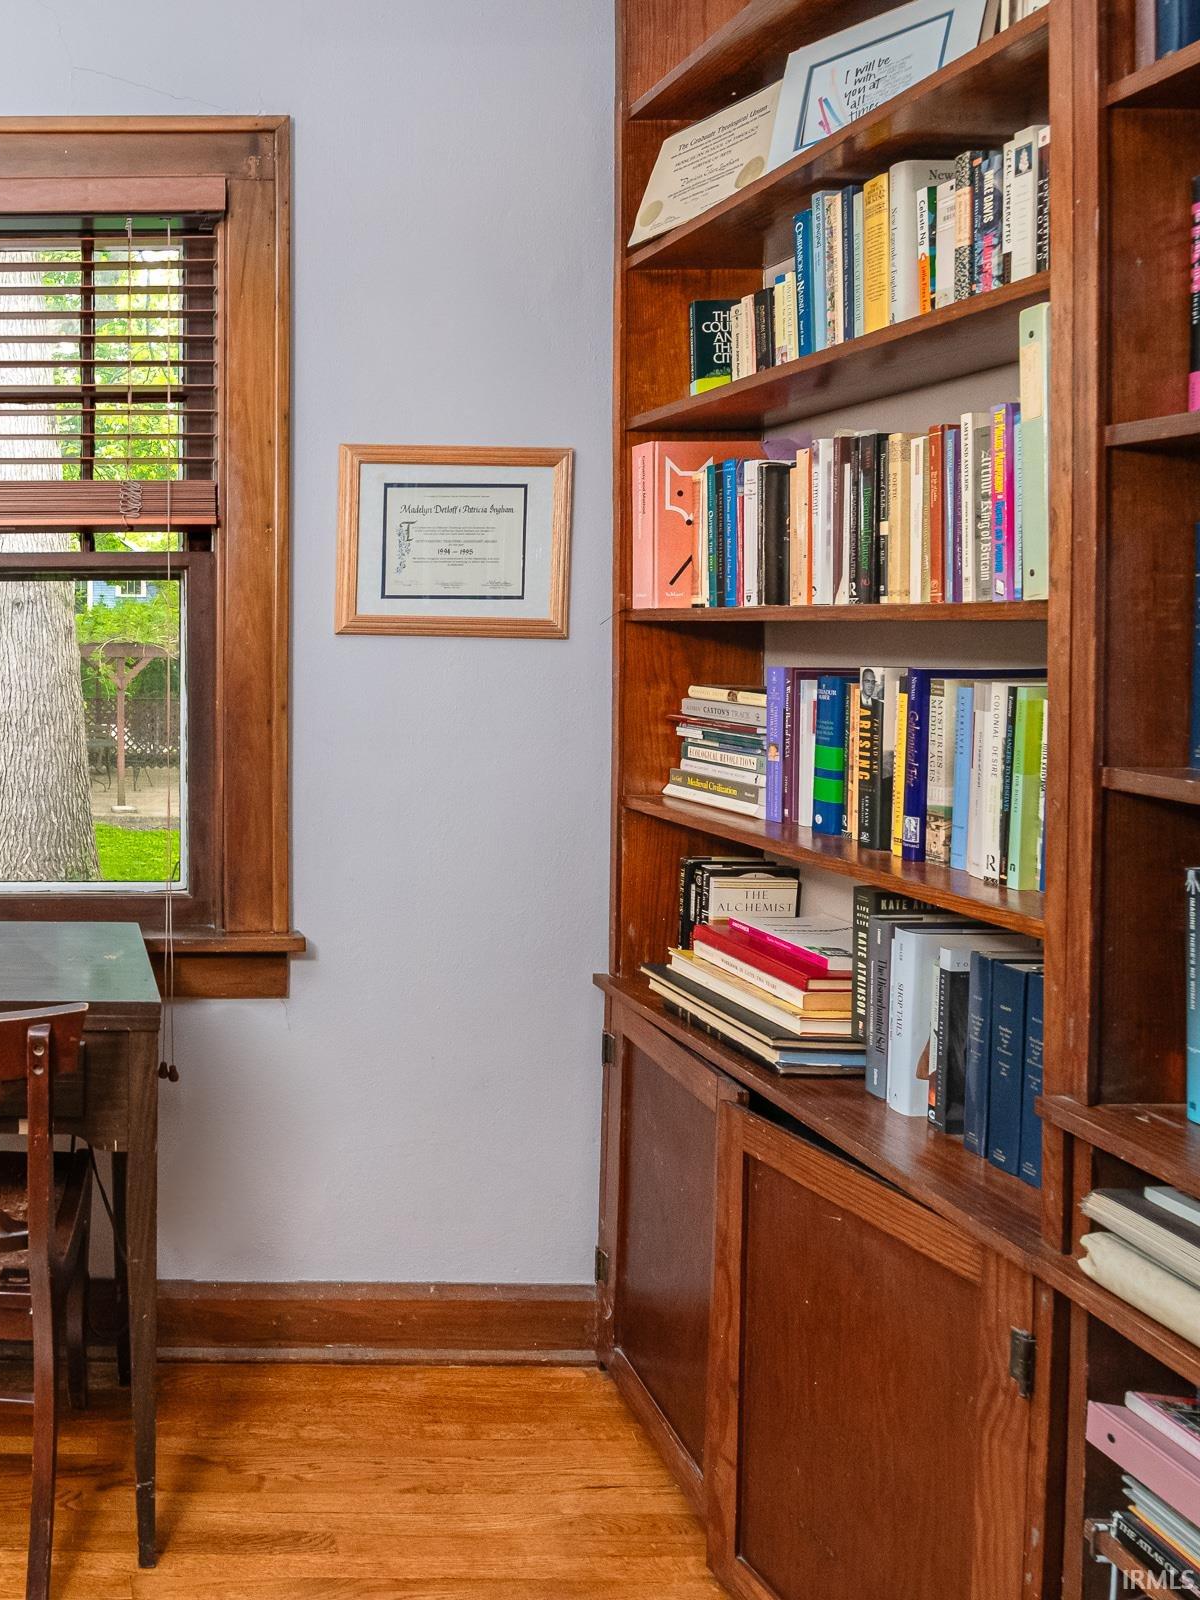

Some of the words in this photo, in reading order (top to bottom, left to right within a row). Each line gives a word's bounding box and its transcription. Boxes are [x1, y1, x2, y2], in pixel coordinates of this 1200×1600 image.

[844, 69, 850, 85] I
[855, 59, 876, 77] will
[877, 56, 890, 68] be
[844, 85, 866, 106] you
[850, 94, 866, 109] all
[983, 169, 994, 195] MIKE
[815, 213, 822, 223] UP
[919, 199, 927, 231] Celeste
[983, 195, 994, 224] DAVIS
[795, 222, 804, 272] COMPANION
[918, 232, 927, 246] Ng
[796, 280, 805, 315] NARNIA
[712, 311, 731, 322] TH
[713, 342, 732, 353] TH
[713, 353, 732, 364] CIT
[400, 504, 433, 516] Madelyn
[462, 504, 488, 514] Patricia
[859, 534, 871, 570] Chaucer
[929, 699, 937, 747] MIDDLE
[992, 695, 1000, 739] COLONIAL
[858, 708, 871, 781] ARISING
[936, 699, 944, 769] MYSTERIES
[991, 745, 999, 778] DESIRE
[687, 776, 709, 791] Medieval
[717, 902, 794, 912] ALCHEMIST
[743, 889, 768, 901] THE
[881, 898, 908, 910] KATE
[856, 904, 870, 914] LIFE
[856, 919, 870, 929] LIFE
[858, 931, 868, 958] KATE
[877, 959, 888, 976] The
[1189, 967, 1196, 979] NO
[856, 962, 867, 1016] ATKINSON
[896, 982, 904, 1009] SHOP
[875, 977, 888, 1035] Disenchanted
[874, 1034, 886, 1056] Self
[1119, 1520, 1137, 1541] THE
[1136, 1538, 1166, 1566] ATLAS
